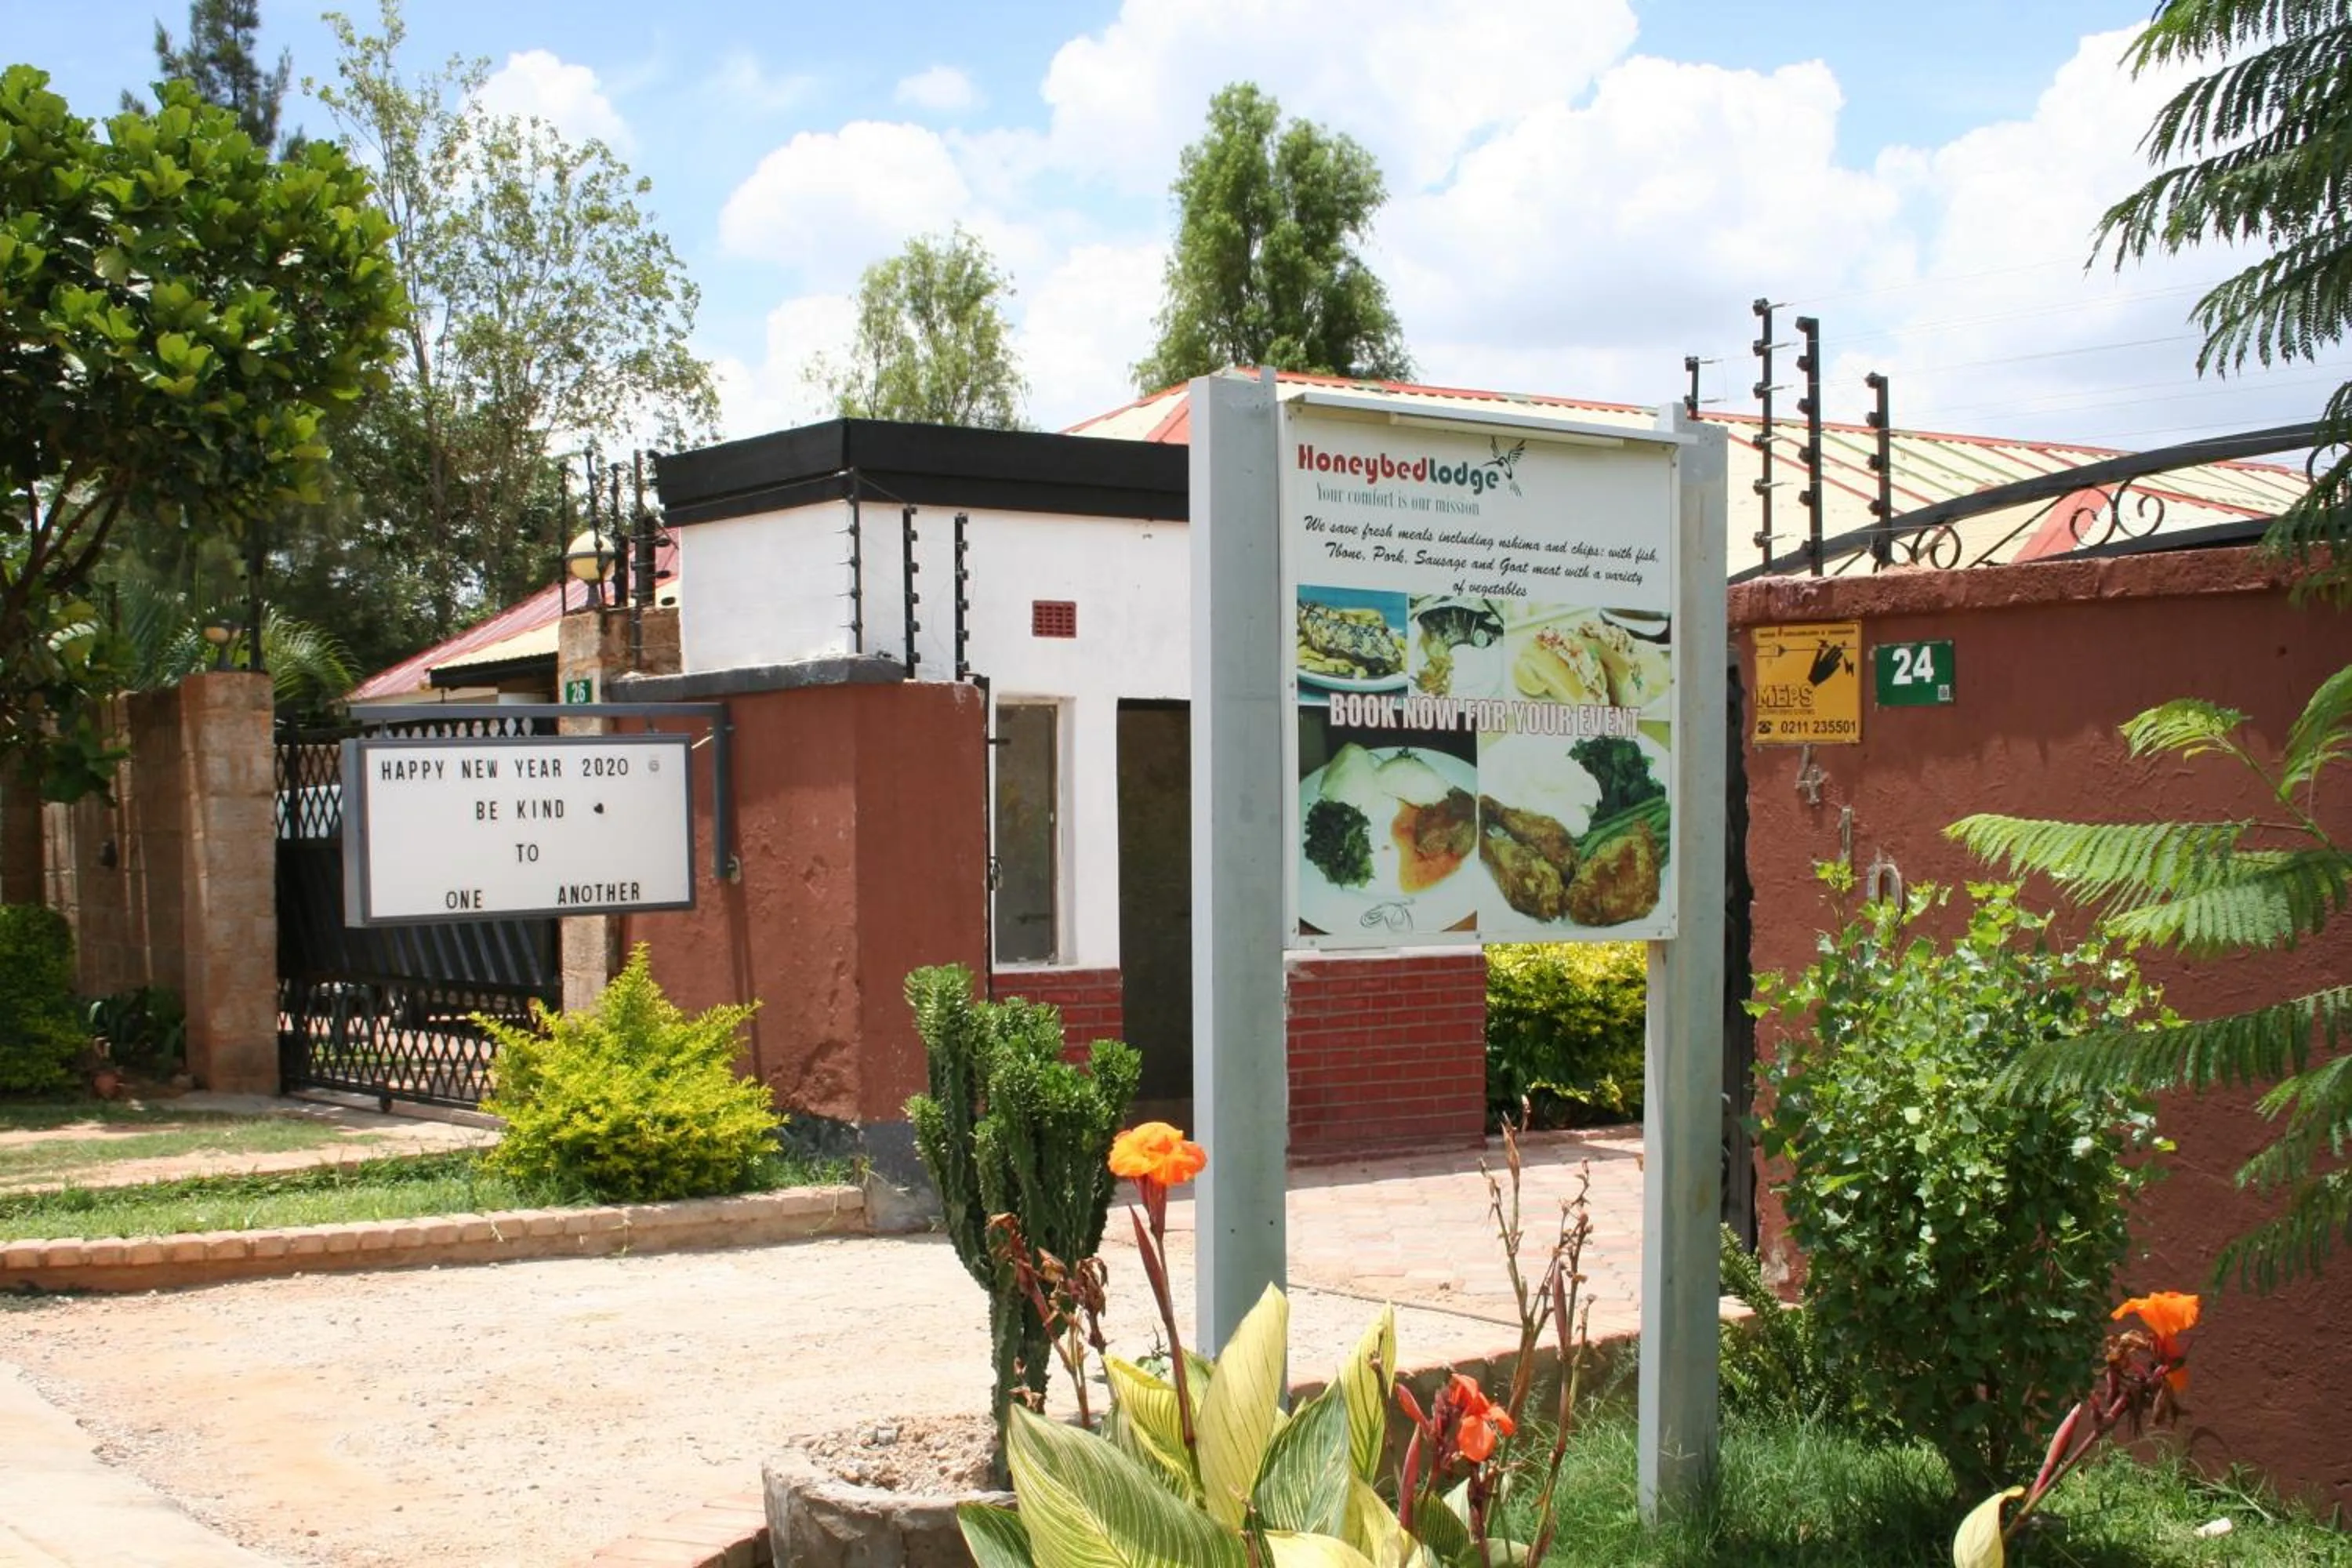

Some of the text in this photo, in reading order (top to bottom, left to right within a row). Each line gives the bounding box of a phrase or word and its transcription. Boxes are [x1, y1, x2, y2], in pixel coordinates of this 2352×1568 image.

[1316, 481, 1480, 515] Your comfort is our mission
[1304, 515, 1325, 532] We
[1361, 522, 1393, 539] fresh
[1398, 528, 1433, 541] meals
[1439, 531, 1494, 550] including
[1498, 535, 1540, 551] nshima
[1544, 542, 1568, 553] and
[1608, 545, 1632, 559] with
[1414, 550, 1466, 571] Sausage
[1471, 558, 1495, 570] and
[1499, 557, 1529, 575] Goat
[1532, 564, 1560, 576] meat
[1565, 564, 1589, 578] with
[1593, 571, 1600, 579] a
[1605, 571, 1643, 586] variety
[1453, 579, 1527, 597] of vegetables
[1892, 645, 1934, 685] 24
[572, 681, 586, 702] 26
[1756, 684, 1813, 707] MEPS
[1330, 693, 1641, 739] BOOK NOW FOR YOUR EVENT
[1780, 720, 1857, 735] 0211 235501
[382, 757, 629, 781] HAPPY NEW YEAR 2020
[476, 799, 565, 821] BE KIND
[514, 843, 539, 863] TO
[445, 880, 641, 909] ONE ANOTHER
